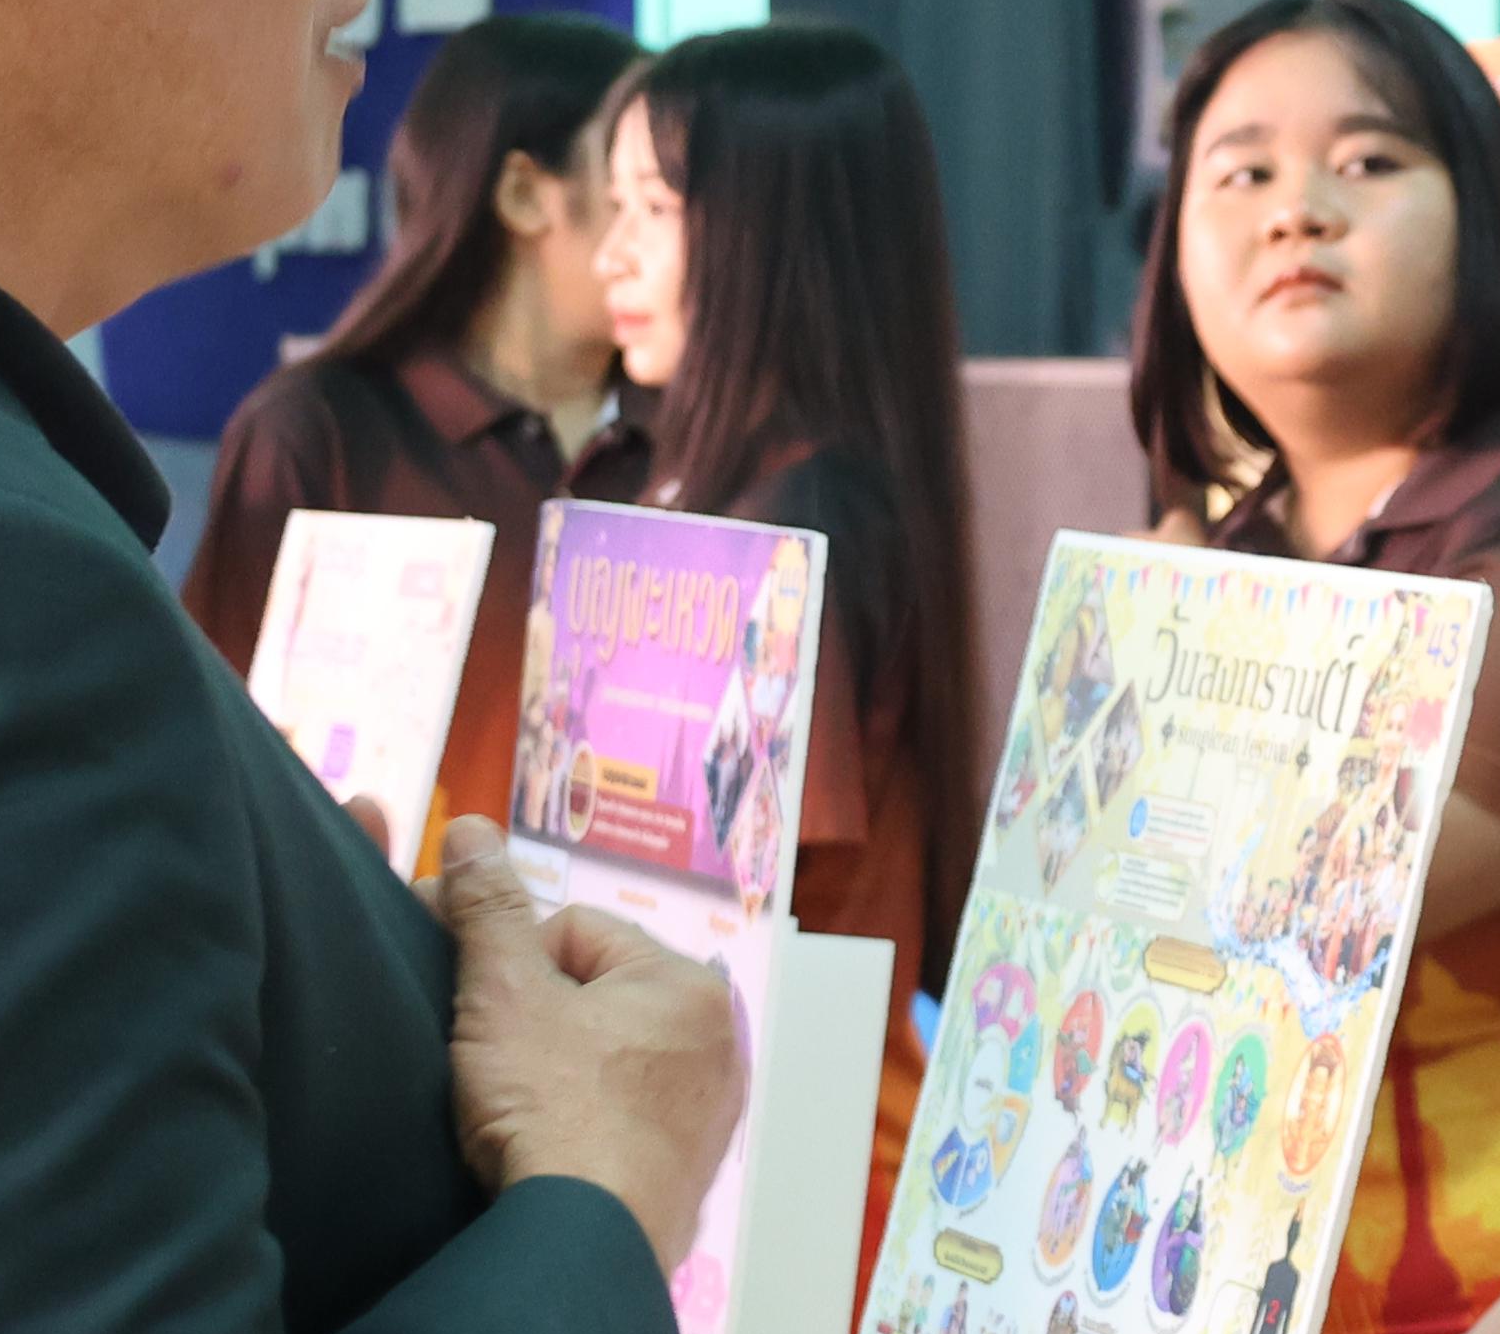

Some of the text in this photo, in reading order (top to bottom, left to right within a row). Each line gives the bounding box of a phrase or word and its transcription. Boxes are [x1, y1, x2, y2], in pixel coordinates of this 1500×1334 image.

[1146, 605, 1365, 736] วันสงกรานต์
[1426, 622, 1460, 669] 43
